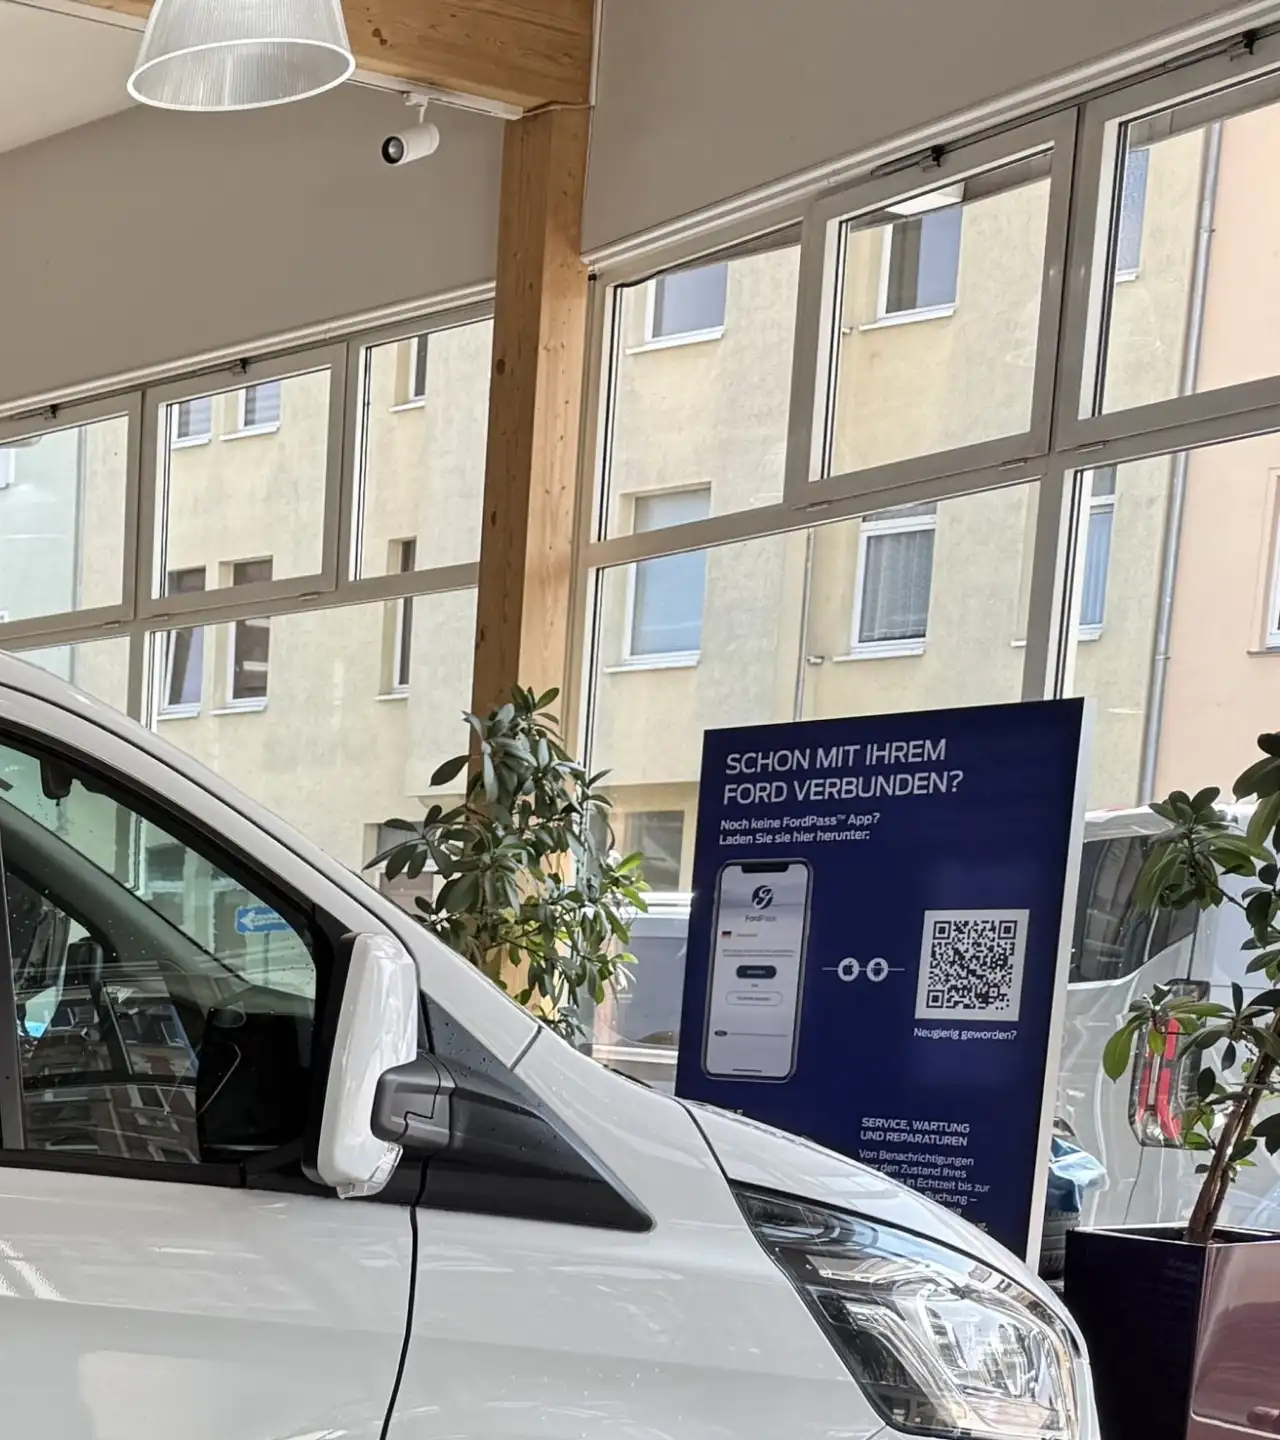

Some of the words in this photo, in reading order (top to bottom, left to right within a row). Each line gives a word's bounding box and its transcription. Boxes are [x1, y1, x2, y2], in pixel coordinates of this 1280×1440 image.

[725, 747, 811, 775] SCHON
[815, 744, 861, 770] MIT
[865, 738, 948, 767] IHREM
[723, 781, 788, 806] FORD
[793, 770, 964, 802] VERBUNDEN?
[720, 818, 749, 831] Noch
[751, 817, 781, 830] keine
[847, 812, 881, 828] App?
[719, 834, 753, 846] Laden
[755, 832, 773, 844] Sie
[774, 832, 791, 844] sie
[793, 830, 814, 843] hier
[816, 829, 871, 842] herunter:
[913, 1028, 960, 1040] Neugierig
[960, 1030, 1018, 1040] geworden?
[861, 1117, 910, 1130] SERVICE,
[912, 1120, 970, 1134] WARTUNG
[860, 1130, 884, 1141] UND
[885, 1132, 968, 1147] REPARATUREN
[859, 1149, 877, 1159] Von
[879, 1151, 975, 1167] Benachrichtigungen
[880, 1162, 899, 1173] den
[900, 1164, 941, 1176] Zustand
[942, 1168, 967, 1179] Ihres
[906, 1178, 915, 1187] in
[917, 1178, 956, 1190] Echtzeit
[958, 1181, 973, 1191] bis
[974, 1184, 991, 1193] zur
